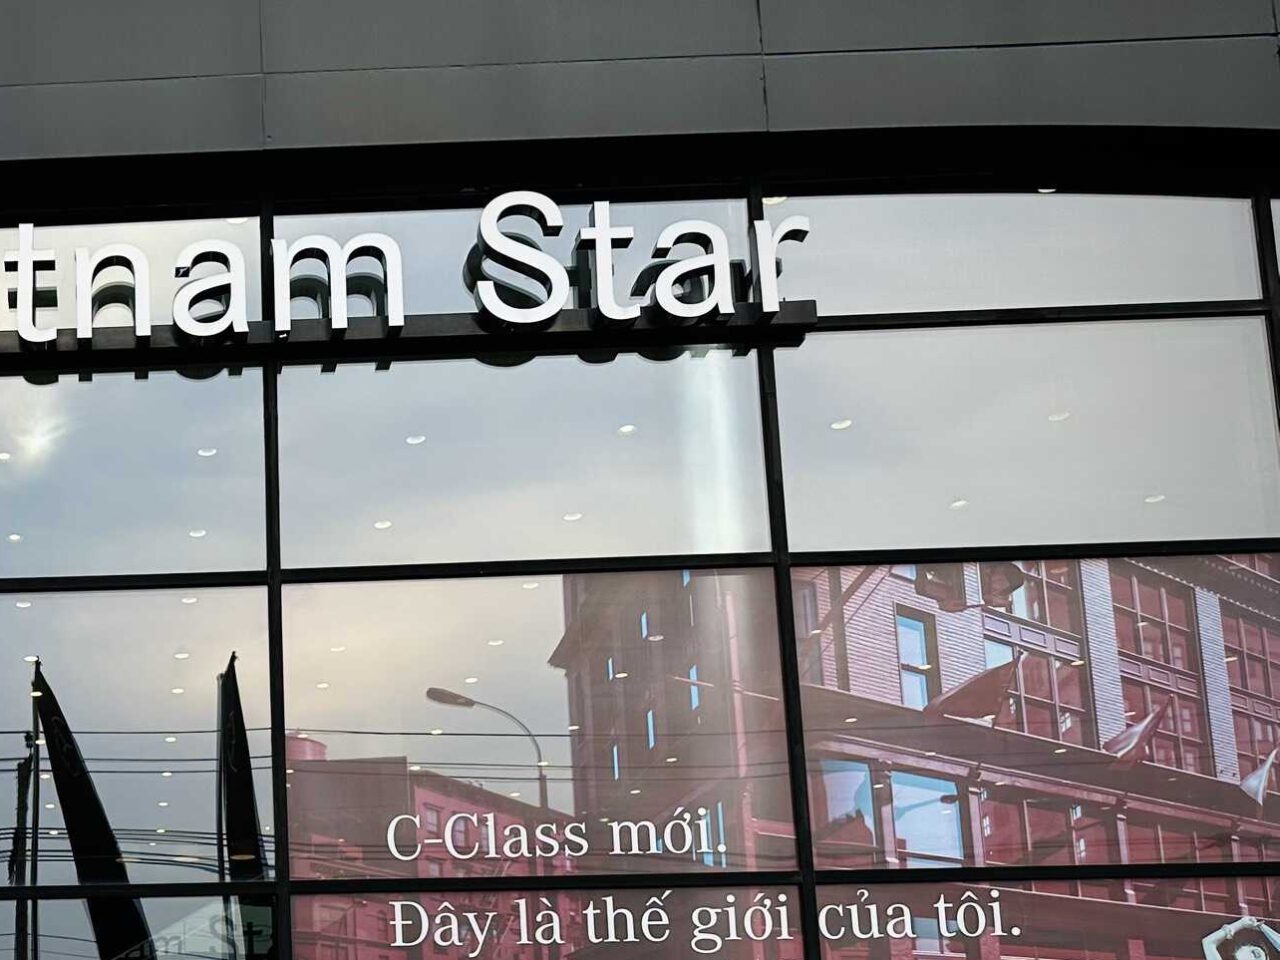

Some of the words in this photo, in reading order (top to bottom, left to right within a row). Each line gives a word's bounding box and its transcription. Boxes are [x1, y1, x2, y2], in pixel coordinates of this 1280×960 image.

[476, 190, 808, 325] Star
[386, 811, 589, 861] C-Class
[609, 805, 727, 855] mới.
[389, 899, 498, 959] Đây
[514, 897, 566, 946] là
[582, 889, 670, 944] thế
[691, 892, 794, 954] giới
[818, 889, 917, 941] của
[933, 888, 1022, 938] tôi.
